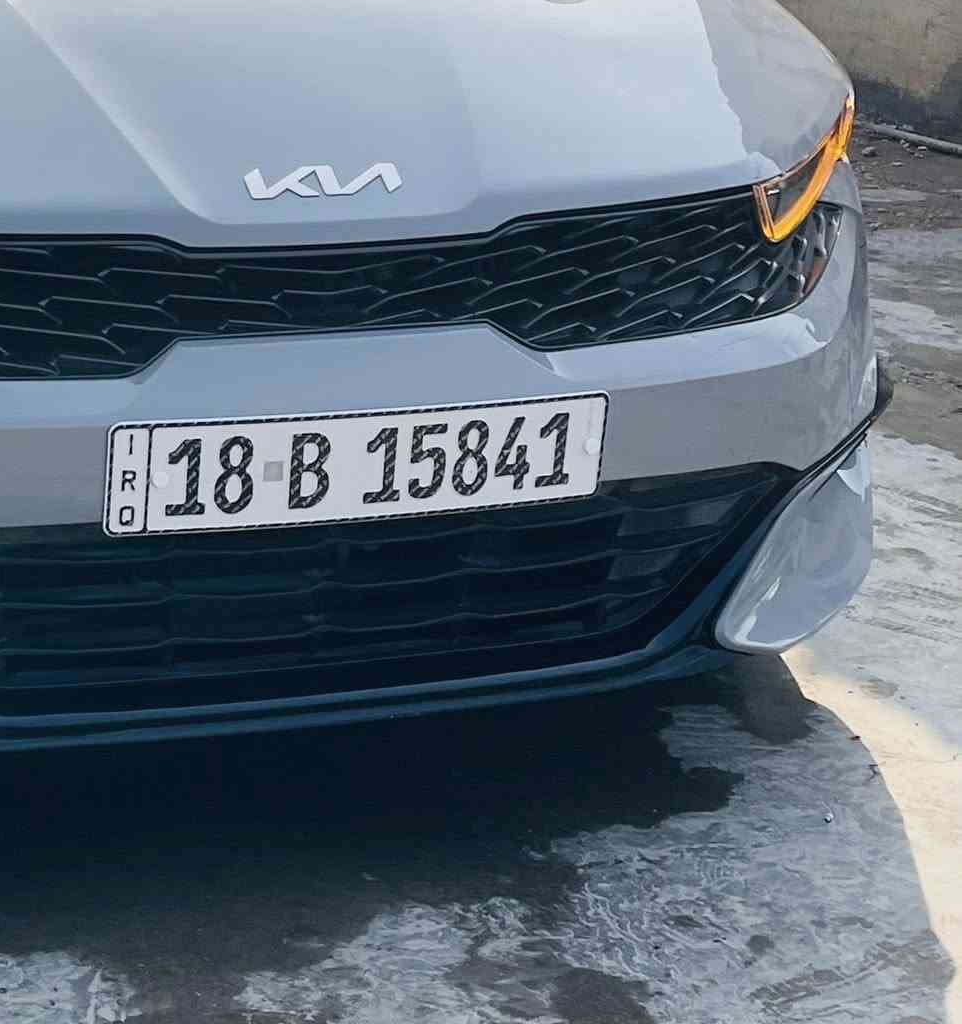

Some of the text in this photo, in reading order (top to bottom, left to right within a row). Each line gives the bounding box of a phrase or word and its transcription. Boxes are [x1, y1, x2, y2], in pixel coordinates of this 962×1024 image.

[165, 412, 570, 516] 18 B 15841
